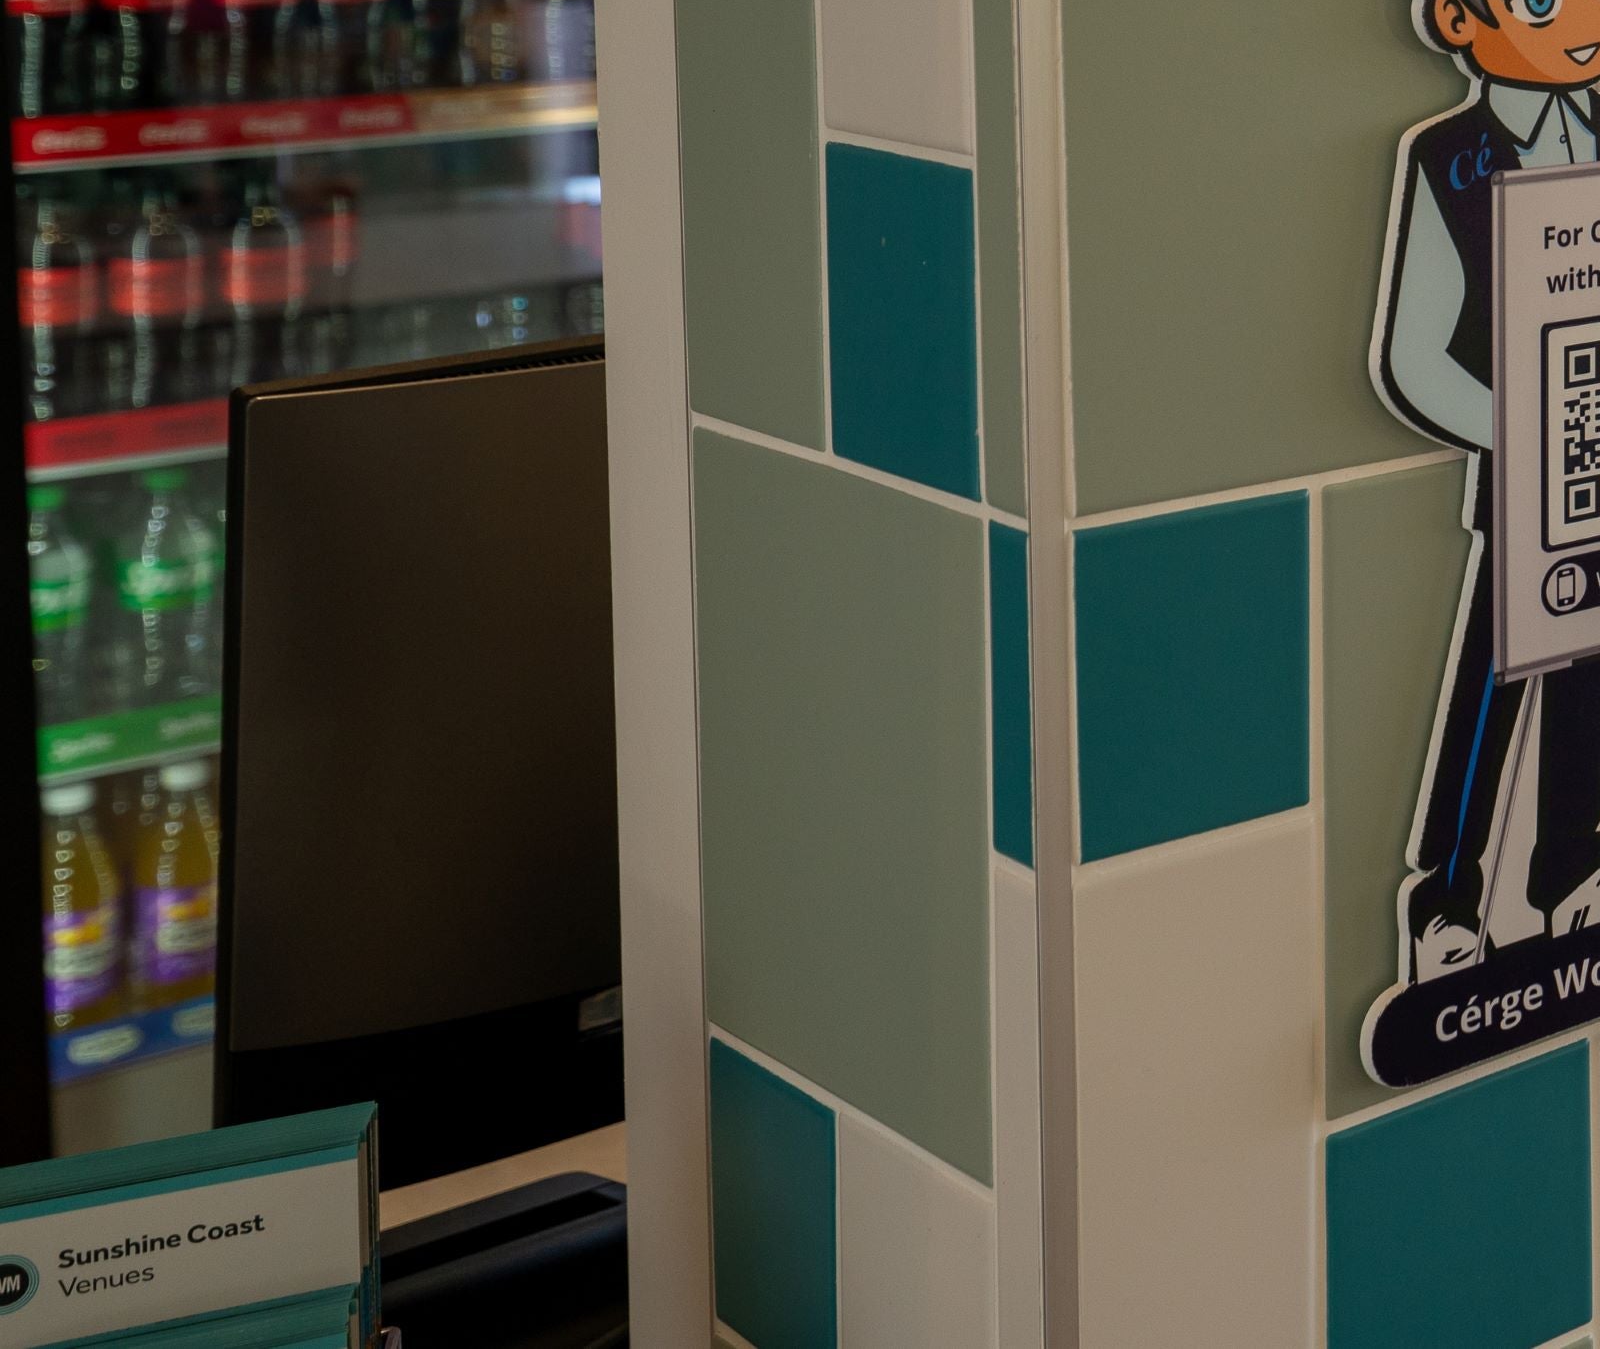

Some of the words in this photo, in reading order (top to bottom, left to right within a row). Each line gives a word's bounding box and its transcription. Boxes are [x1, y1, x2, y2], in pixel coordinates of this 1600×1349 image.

[1543, 222, 1584, 250] For
[1436, 983, 1544, 1043] Cérge
[58, 1233, 182, 1269] Sunshine
[187, 1214, 266, 1244] Coast
[58, 1265, 155, 1297] Venues
